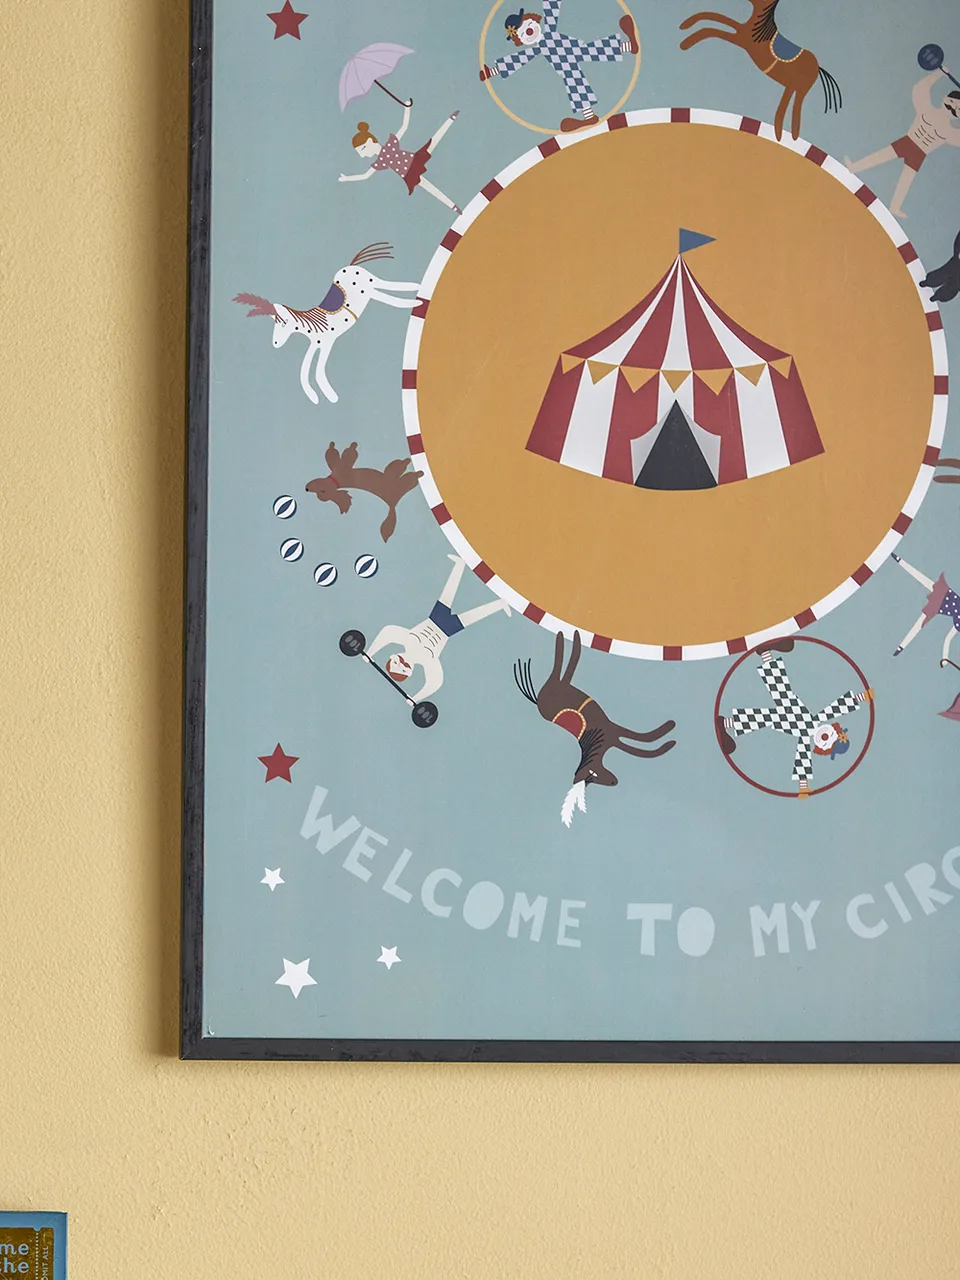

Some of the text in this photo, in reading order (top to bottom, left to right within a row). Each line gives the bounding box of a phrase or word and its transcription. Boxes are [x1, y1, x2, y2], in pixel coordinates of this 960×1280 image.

[344, 635, 361, 652] 100
[416, 706, 433, 724] 100
[300, 785, 587, 948] WELCOME
[626, 902, 716, 958] TO
[749, 899, 821, 958] MY
